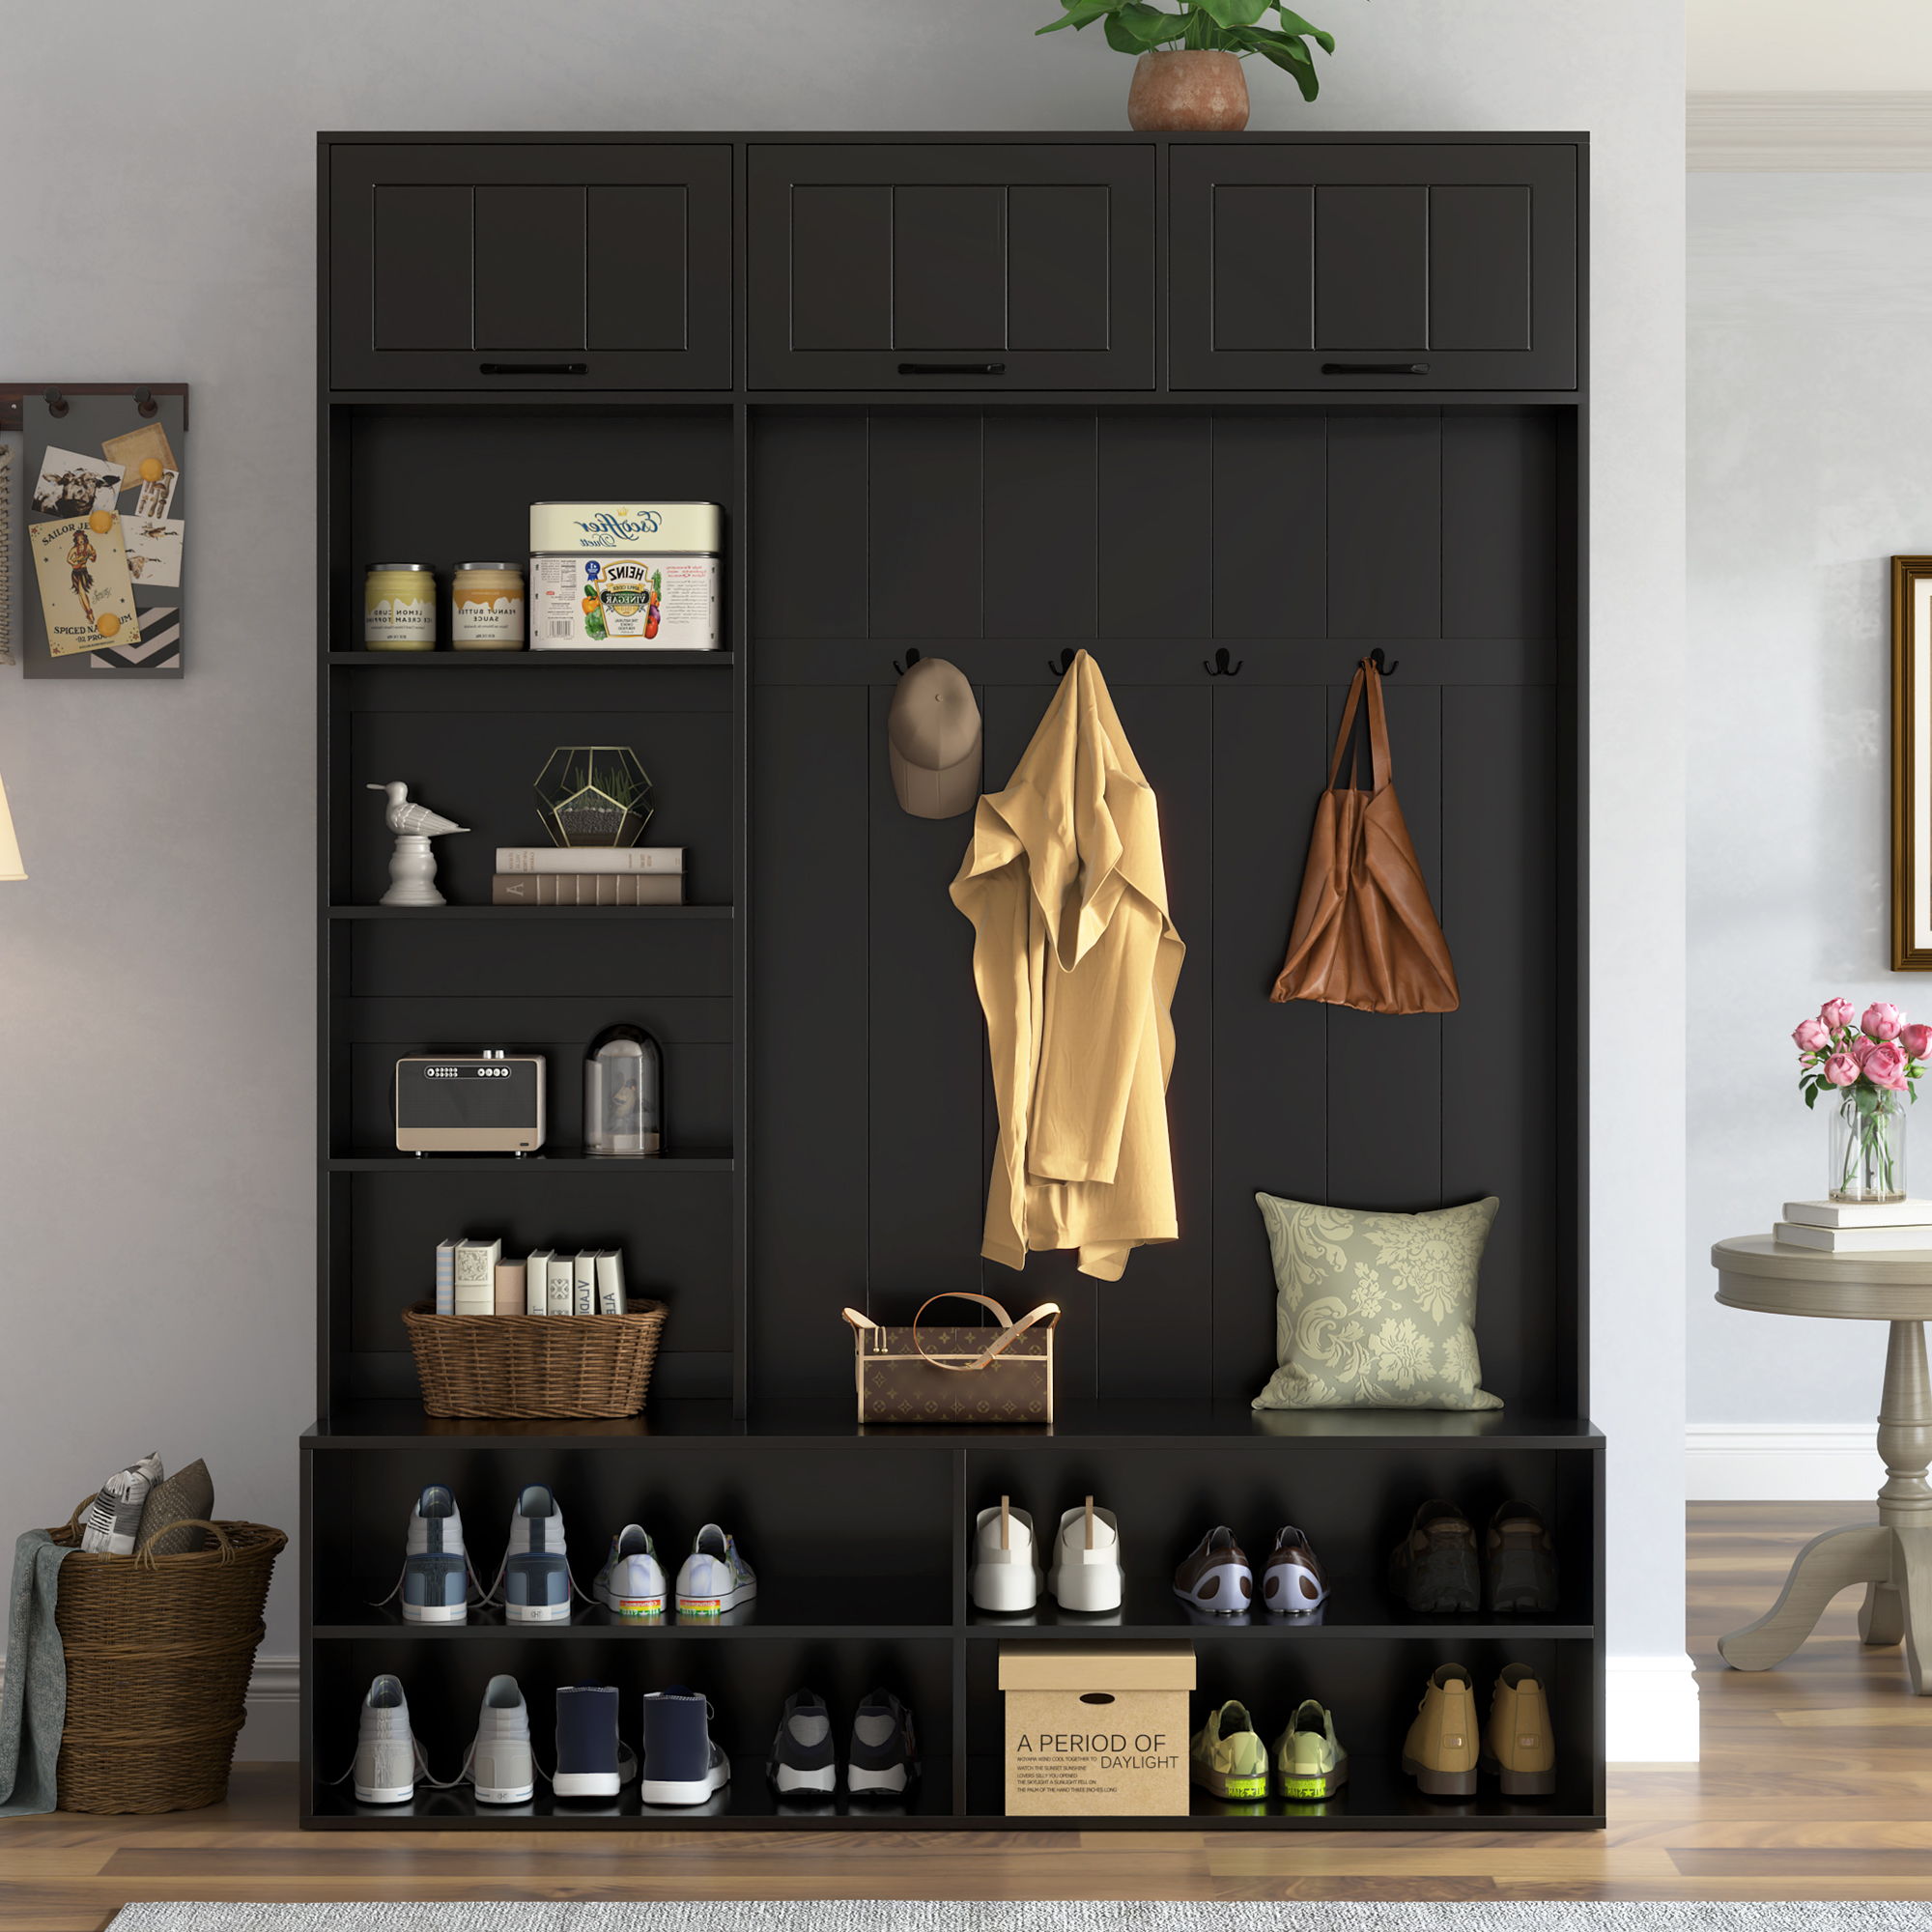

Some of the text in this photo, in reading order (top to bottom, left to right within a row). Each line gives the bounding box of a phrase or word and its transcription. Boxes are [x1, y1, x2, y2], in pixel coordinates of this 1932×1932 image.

[42, 523, 75, 546] SAILOR
[54, 626, 86, 635] SPICED
[1017, 1734, 1166, 1752] A PERIOD OF
[1100, 1755, 1179, 1769] DAYLIGHT
